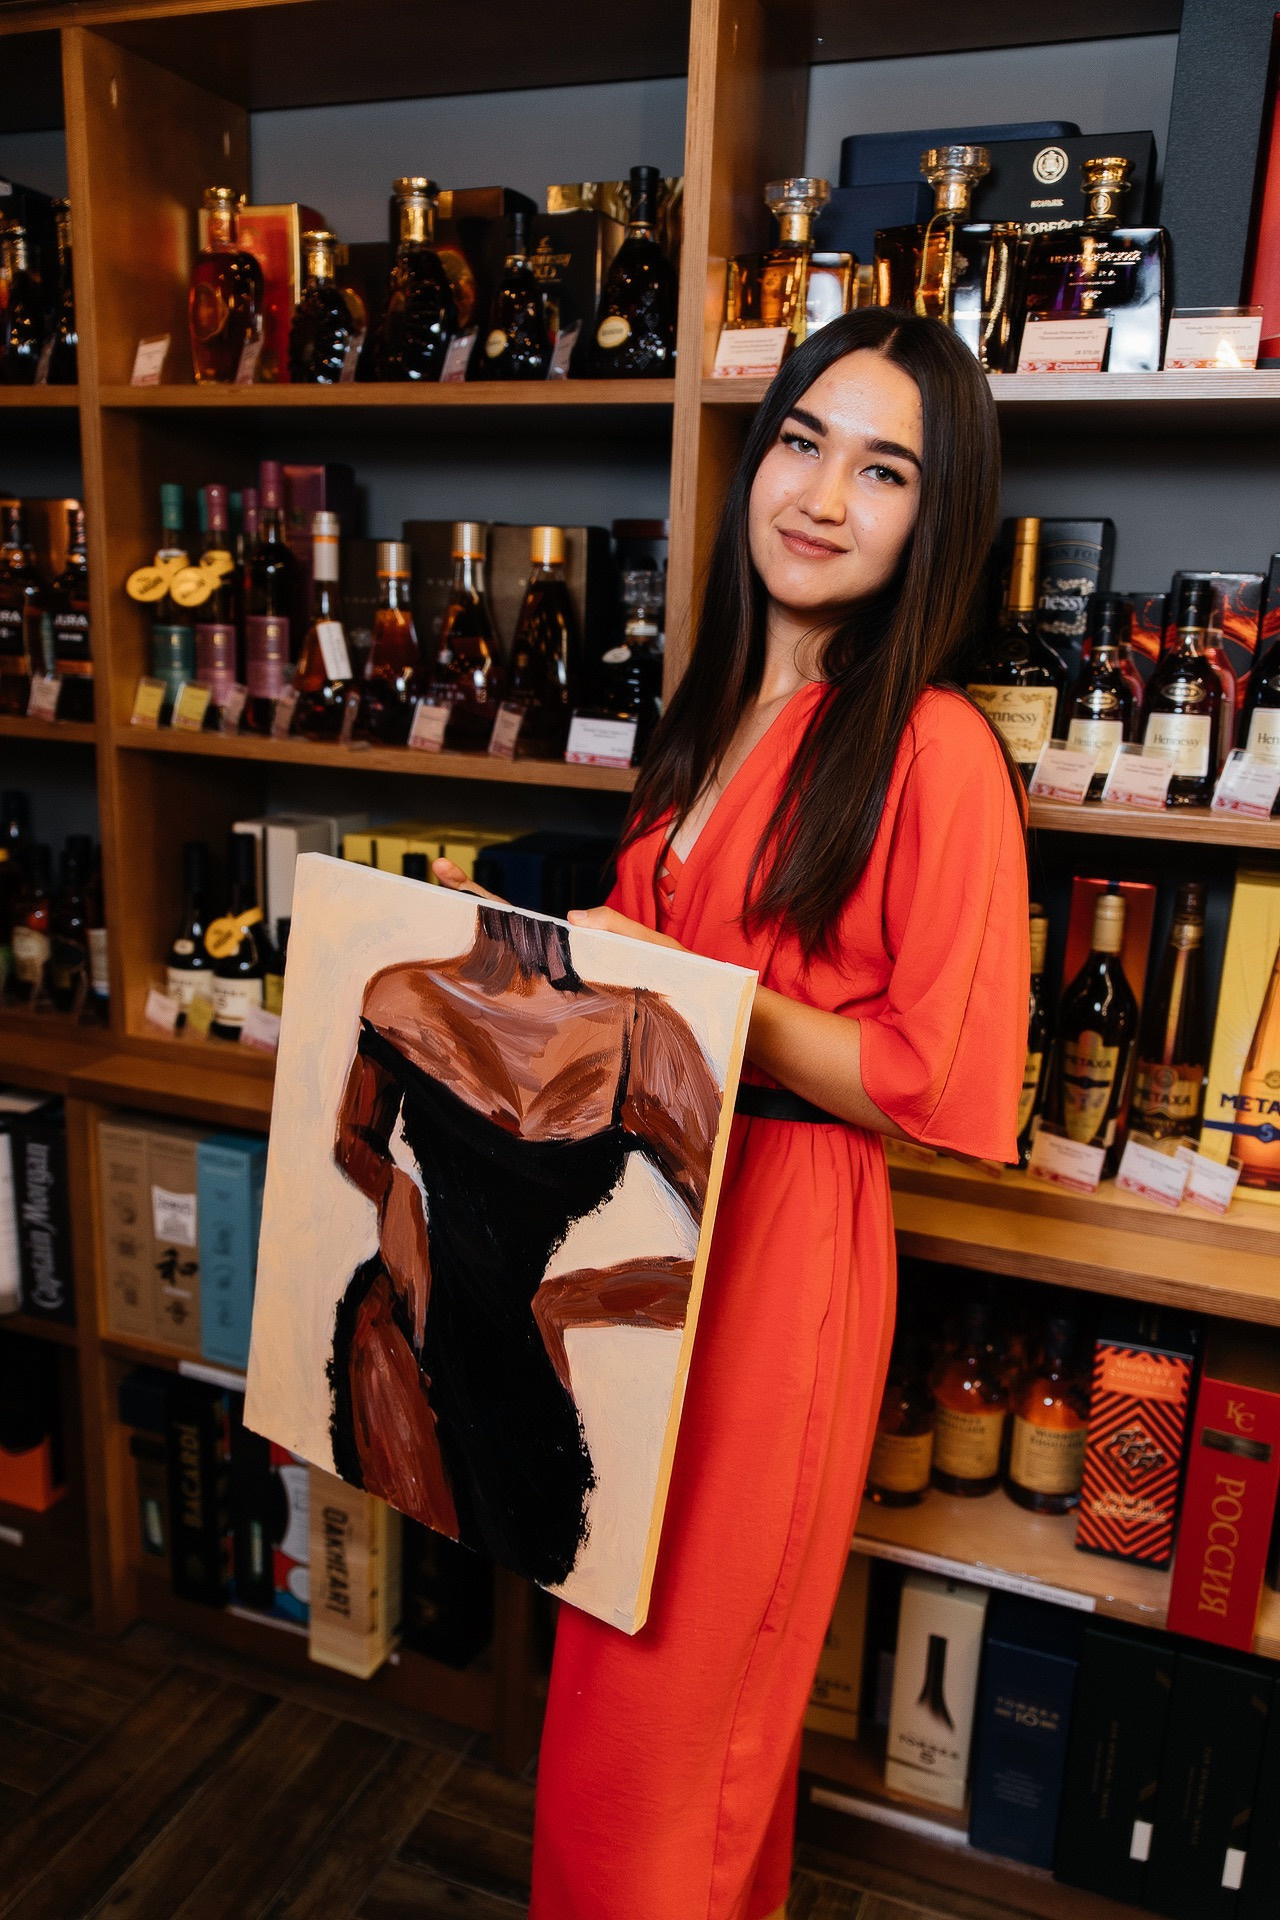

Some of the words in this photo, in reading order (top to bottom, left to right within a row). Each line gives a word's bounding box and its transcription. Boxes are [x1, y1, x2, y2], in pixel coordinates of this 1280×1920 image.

[1153, 733, 1199, 748] Hennessy
[1220, 1093, 1280, 1115] META
[321, 1504, 351, 1619] OAKHEART
[1198, 1473, 1247, 1617] РОССИЯ
